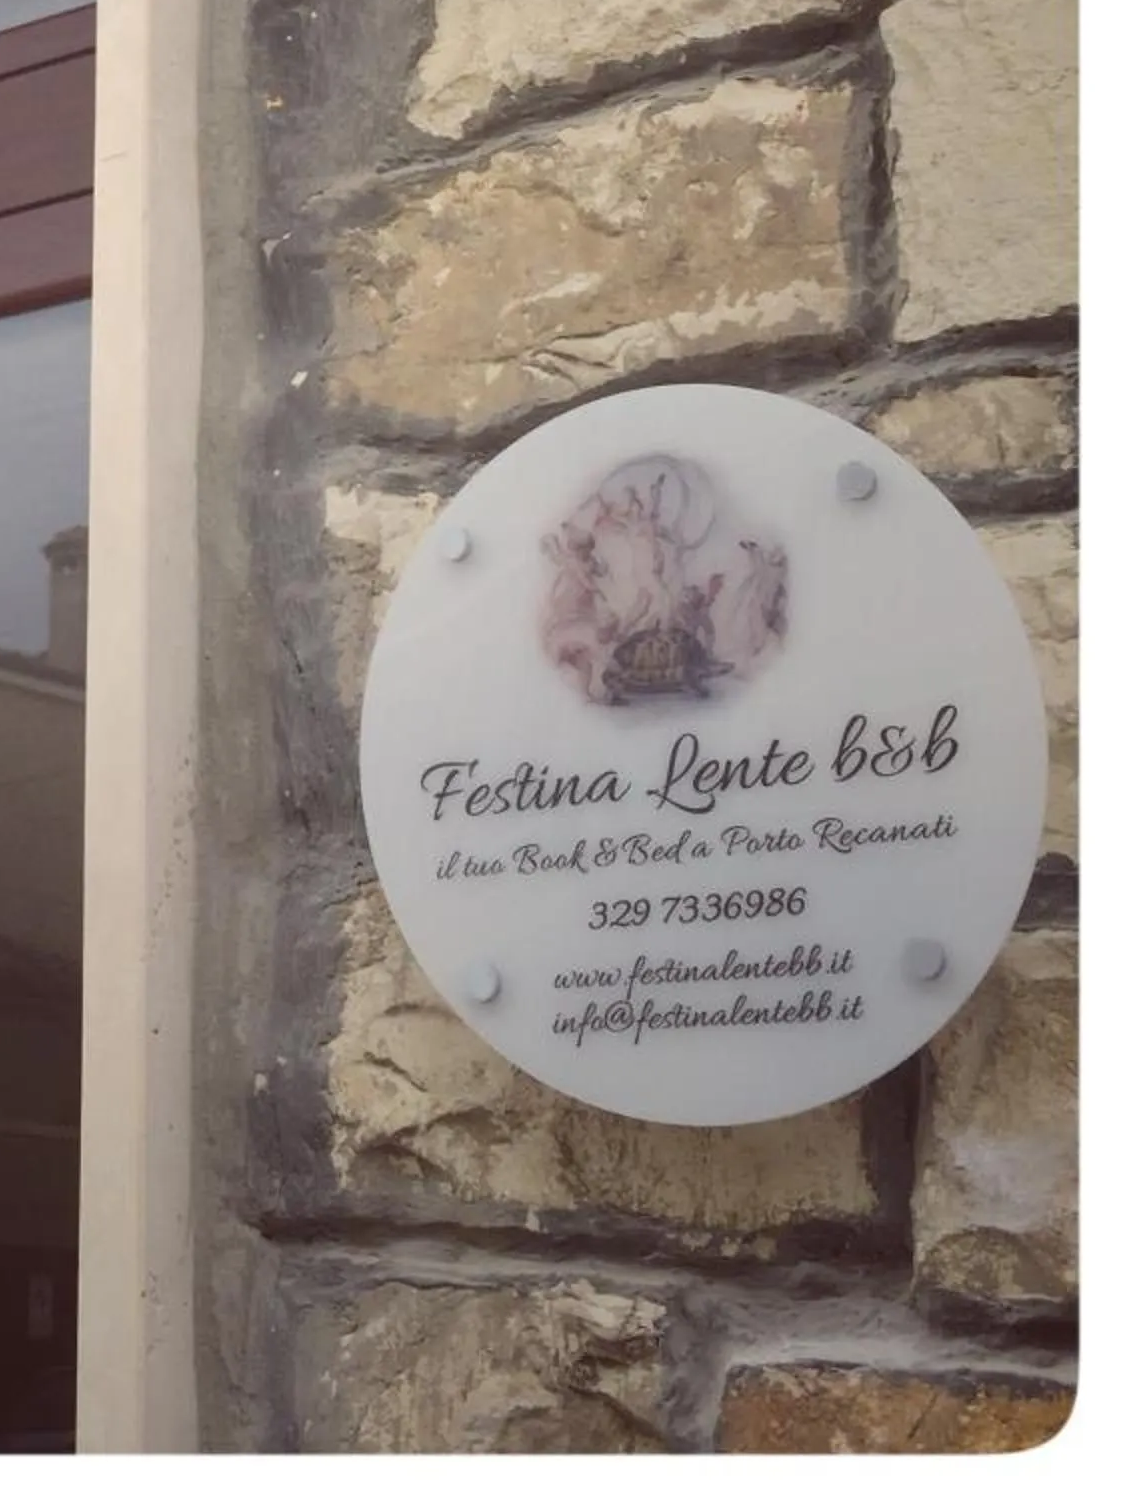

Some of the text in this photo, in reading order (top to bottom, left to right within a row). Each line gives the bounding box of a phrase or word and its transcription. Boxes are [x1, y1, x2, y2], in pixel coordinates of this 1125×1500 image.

[420, 704, 960, 820] Festina Lente b&b
[436, 851, 461, 880] il
[464, 855, 505, 877] tuo
[512, 843, 588, 875] Book
[691, 840, 713, 859] a
[721, 825, 804, 856] Porto
[812, 815, 957, 854] Recanati
[588, 887, 808, 930] 329 7336986
[554, 944, 854, 1000] www.festinalentebb.it
[552, 990, 864, 1047] info@festinalentebb.it
